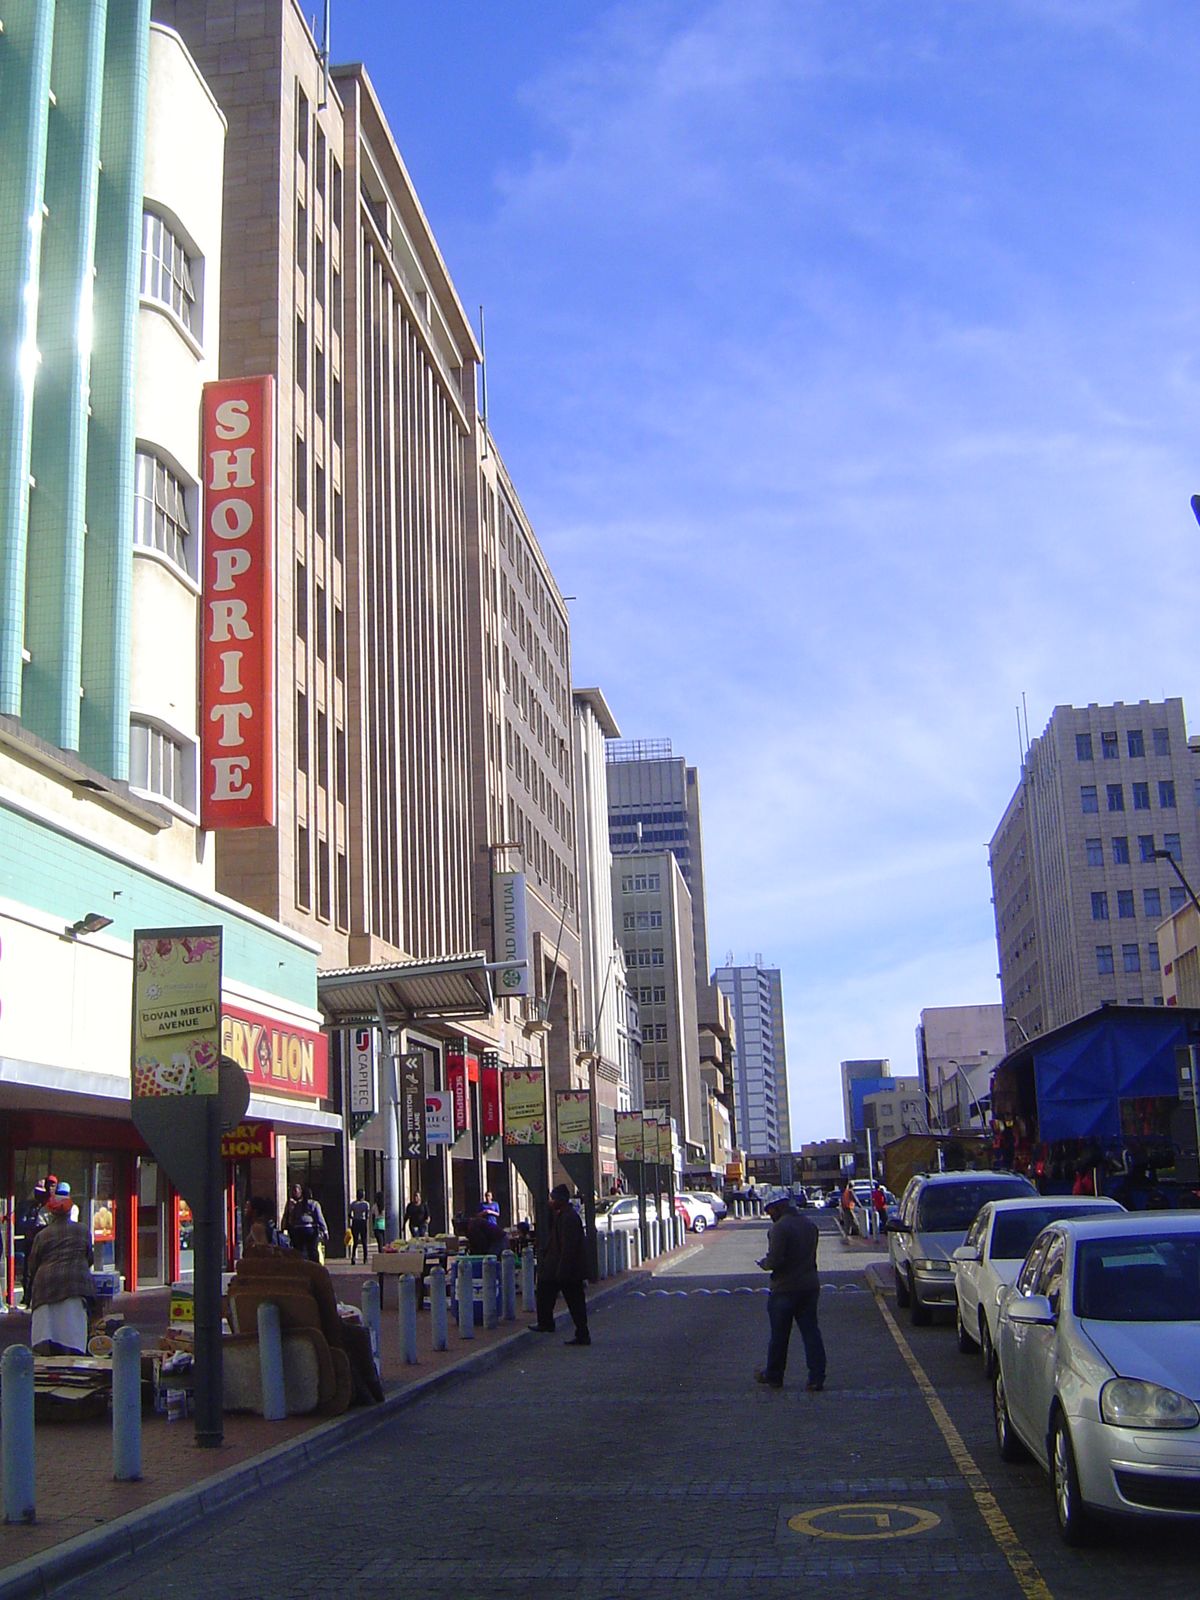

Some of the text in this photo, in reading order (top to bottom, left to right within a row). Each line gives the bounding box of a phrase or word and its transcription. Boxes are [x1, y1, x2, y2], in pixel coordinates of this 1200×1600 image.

[208, 398, 256, 802] SHOPRITE
[503, 879, 516, 934] MUTUAL
[142, 1004, 213, 1022] GOVAN MBEKI
[158, 1018, 200, 1031] AVENUE
[271, 1028, 315, 1087] LION
[358, 1053, 369, 1106] CAPITEC
[406, 1094, 414, 1131] TITTERTON
[455, 1075, 464, 1127] SCORPION
[220, 1141, 262, 1155] LION
